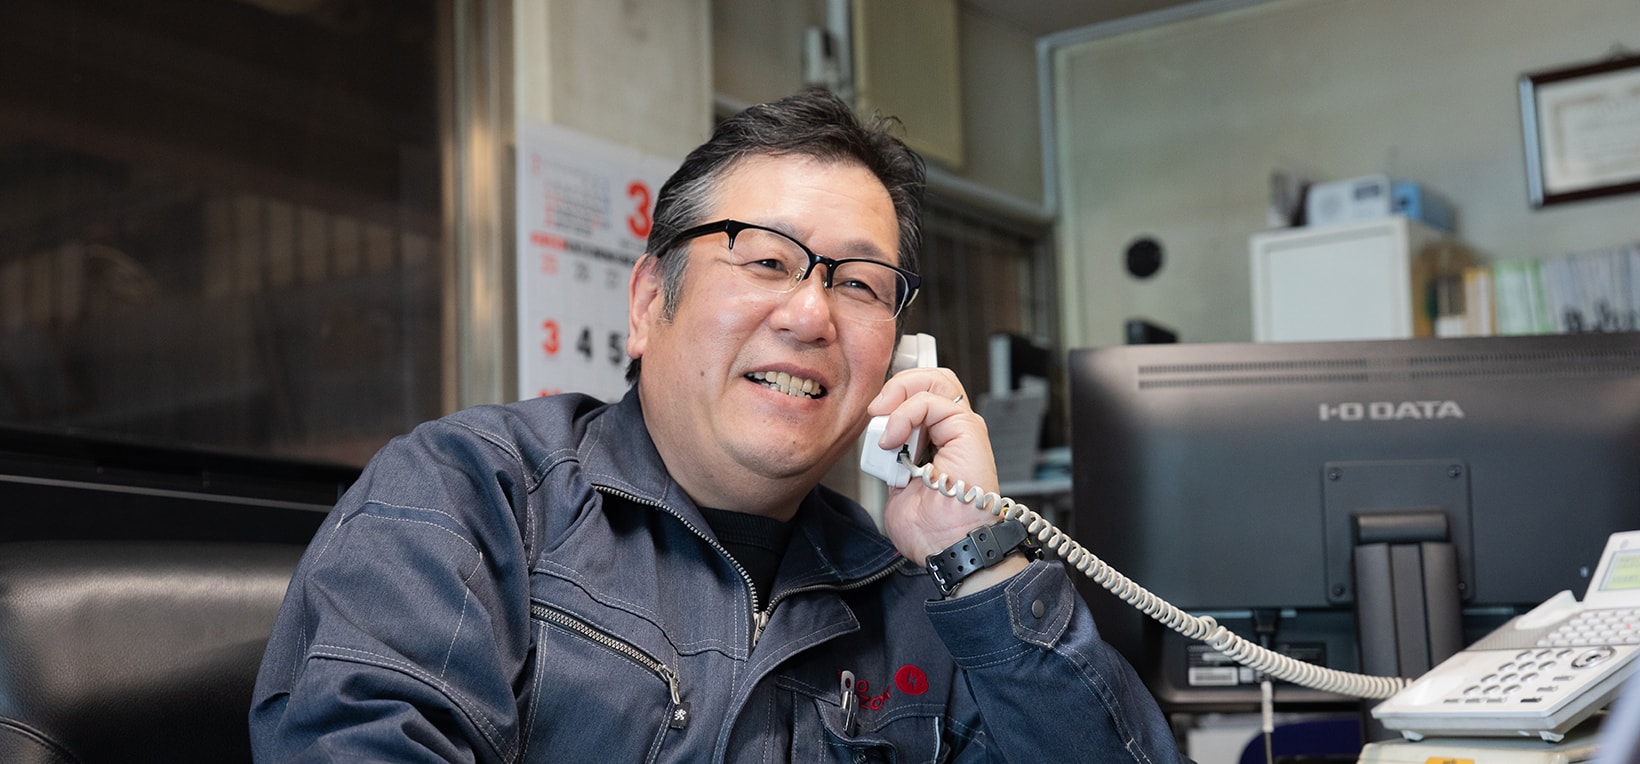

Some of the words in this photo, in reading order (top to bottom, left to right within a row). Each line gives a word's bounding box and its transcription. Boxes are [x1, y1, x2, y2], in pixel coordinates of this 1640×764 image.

[626, 180, 653, 240] 3
[541, 318, 560, 356] 3
[576, 326, 593, 360] 4
[608, 331, 624, 366] 5
[1368, 400, 1465, 420] DATA
